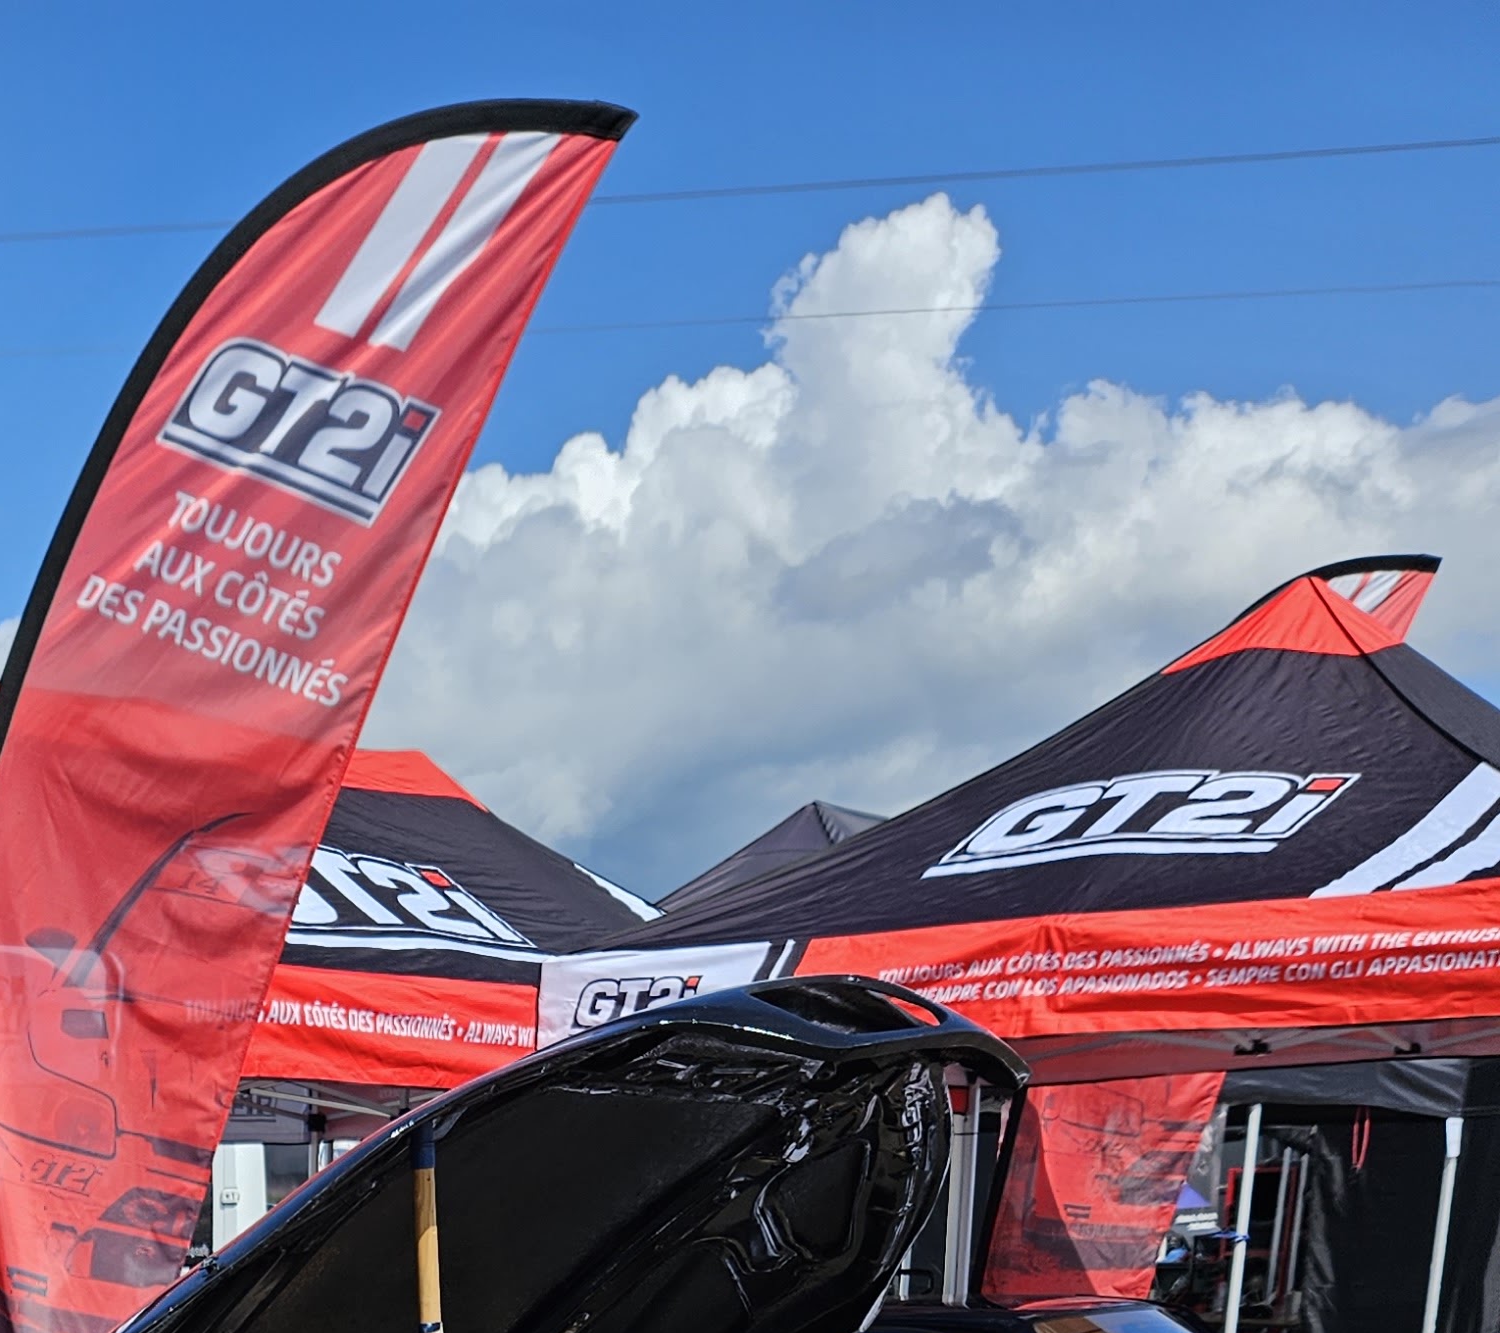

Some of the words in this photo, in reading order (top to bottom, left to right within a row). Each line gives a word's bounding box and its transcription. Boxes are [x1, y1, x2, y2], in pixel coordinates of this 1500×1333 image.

[180, 340, 429, 497] GT2i
[167, 490, 343, 588] TOUJOURS
[132, 539, 216, 597] AUX
[214, 570, 326, 640] CÔTÉS
[76, 573, 146, 625] DES
[141, 598, 349, 707] PASSIONNÉS
[960, 772, 1350, 858] GT2i
[879, 963, 965, 984] TOUJOURS
[966, 955, 1005, 980] AUX
[1006, 950, 1061, 976] CÔTÉS
[1062, 949, 1098, 972] DES
[1099, 939, 1209, 971] PASSIONNÉS
[1225, 937, 1311, 961] ALWAYS
[1312, 933, 1367, 955] WITH
[1370, 931, 1412, 950] THE
[983, 978, 1020, 1000] CON
[1021, 976, 1058, 997] LOS
[1058, 969, 1190, 995] APASIONADOS
[1204, 963, 1285, 988] SEMPRE
[1284, 961, 1327, 982] CON
[1329, 958, 1363, 979] GLI
[1364, 949, 1500, 977] APPASIONAT
[266, 1000, 302, 1025] AUX
[303, 1000, 349, 1031] CÔTÉS
[348, 1007, 376, 1034] DES
[376, 1013, 457, 1042] PASSIONNÉS
[463, 1021, 518, 1048] ALWAYS
